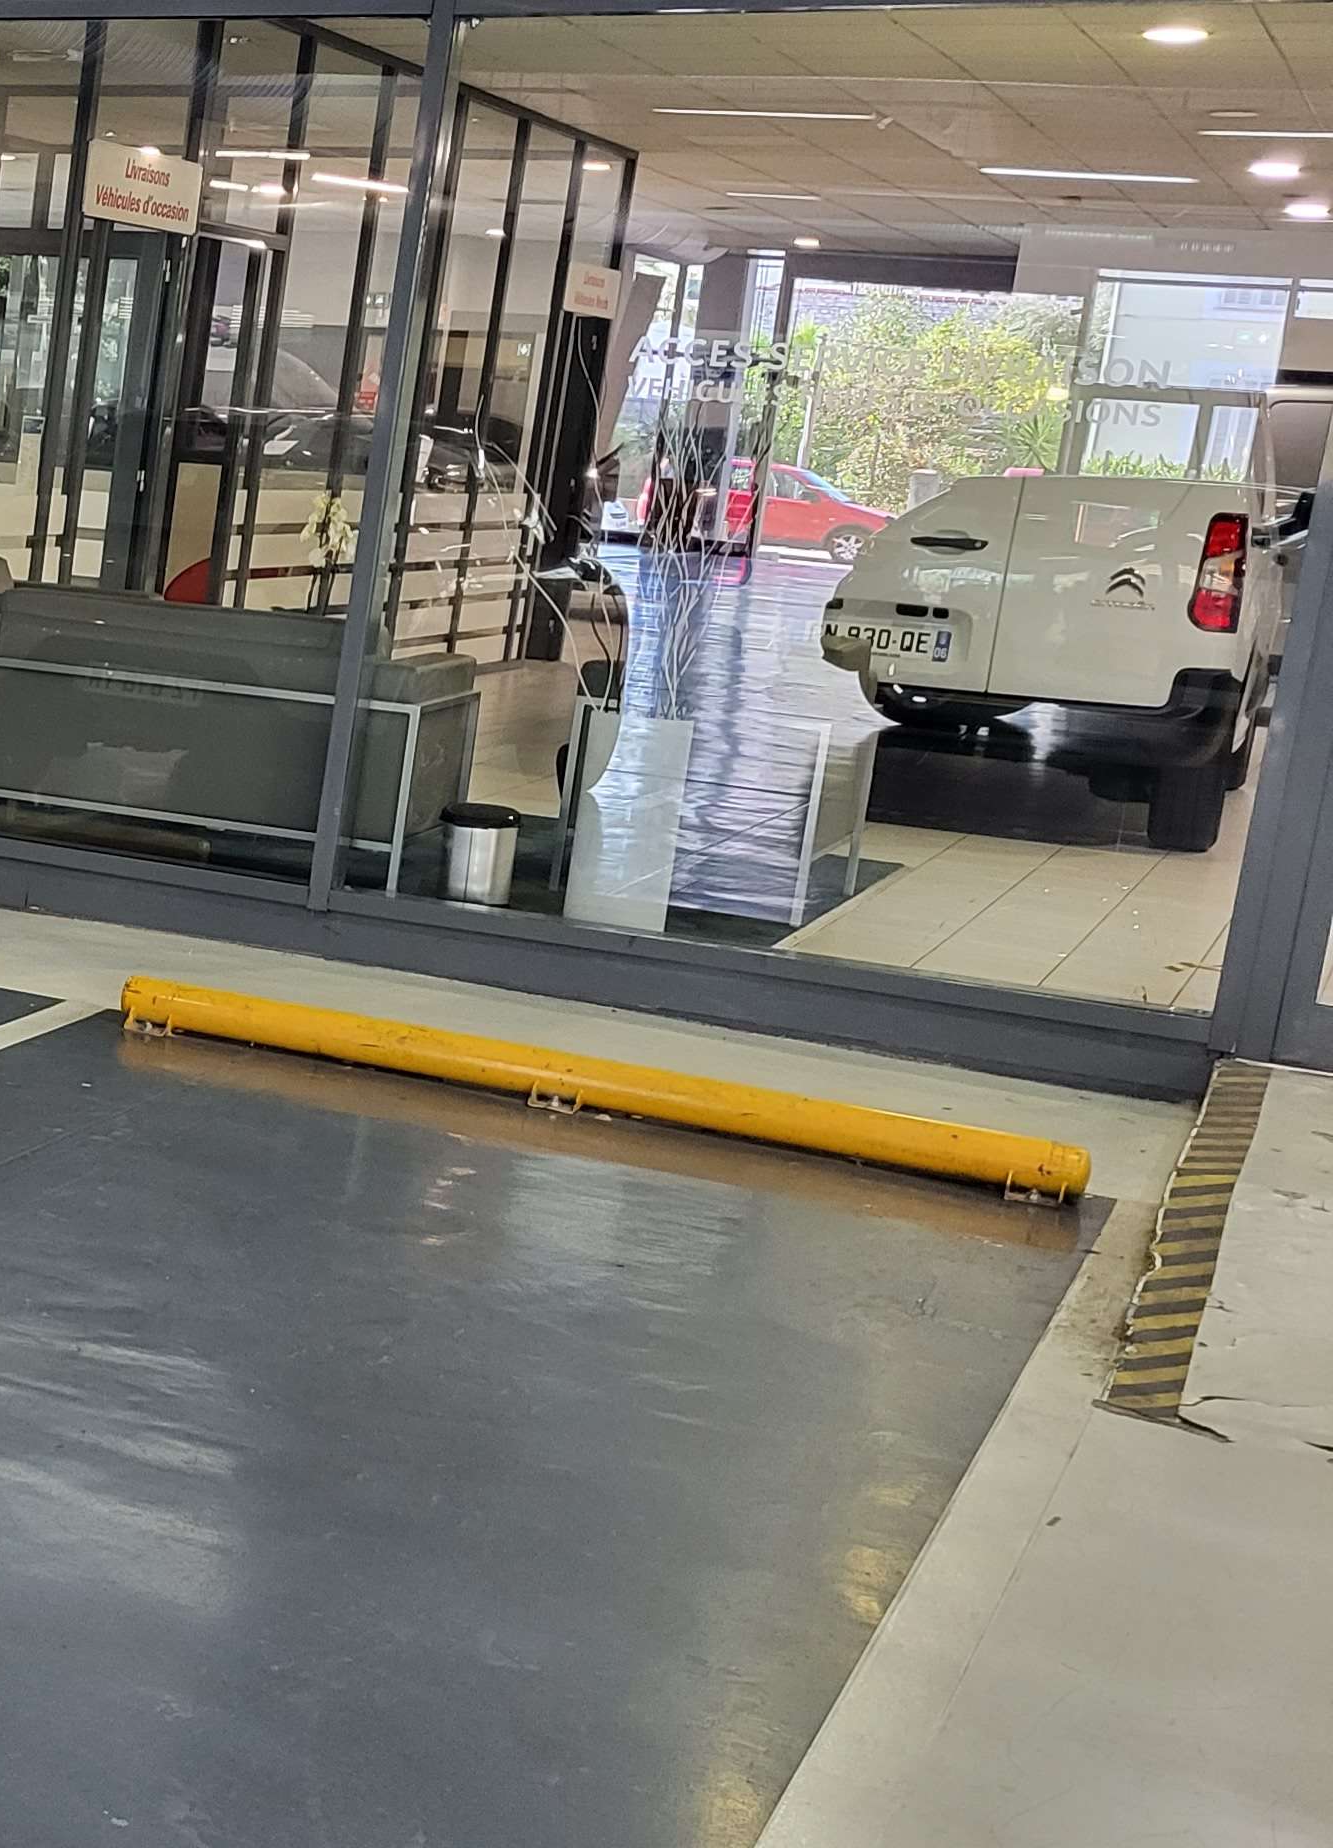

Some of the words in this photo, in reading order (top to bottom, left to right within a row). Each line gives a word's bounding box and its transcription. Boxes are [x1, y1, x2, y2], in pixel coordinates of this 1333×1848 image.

[124, 157, 171, 188] Livraisons
[95, 183, 142, 214] Véhicules
[142, 194, 190, 222] d'occasion
[628, 335, 753, 370] ACCES
